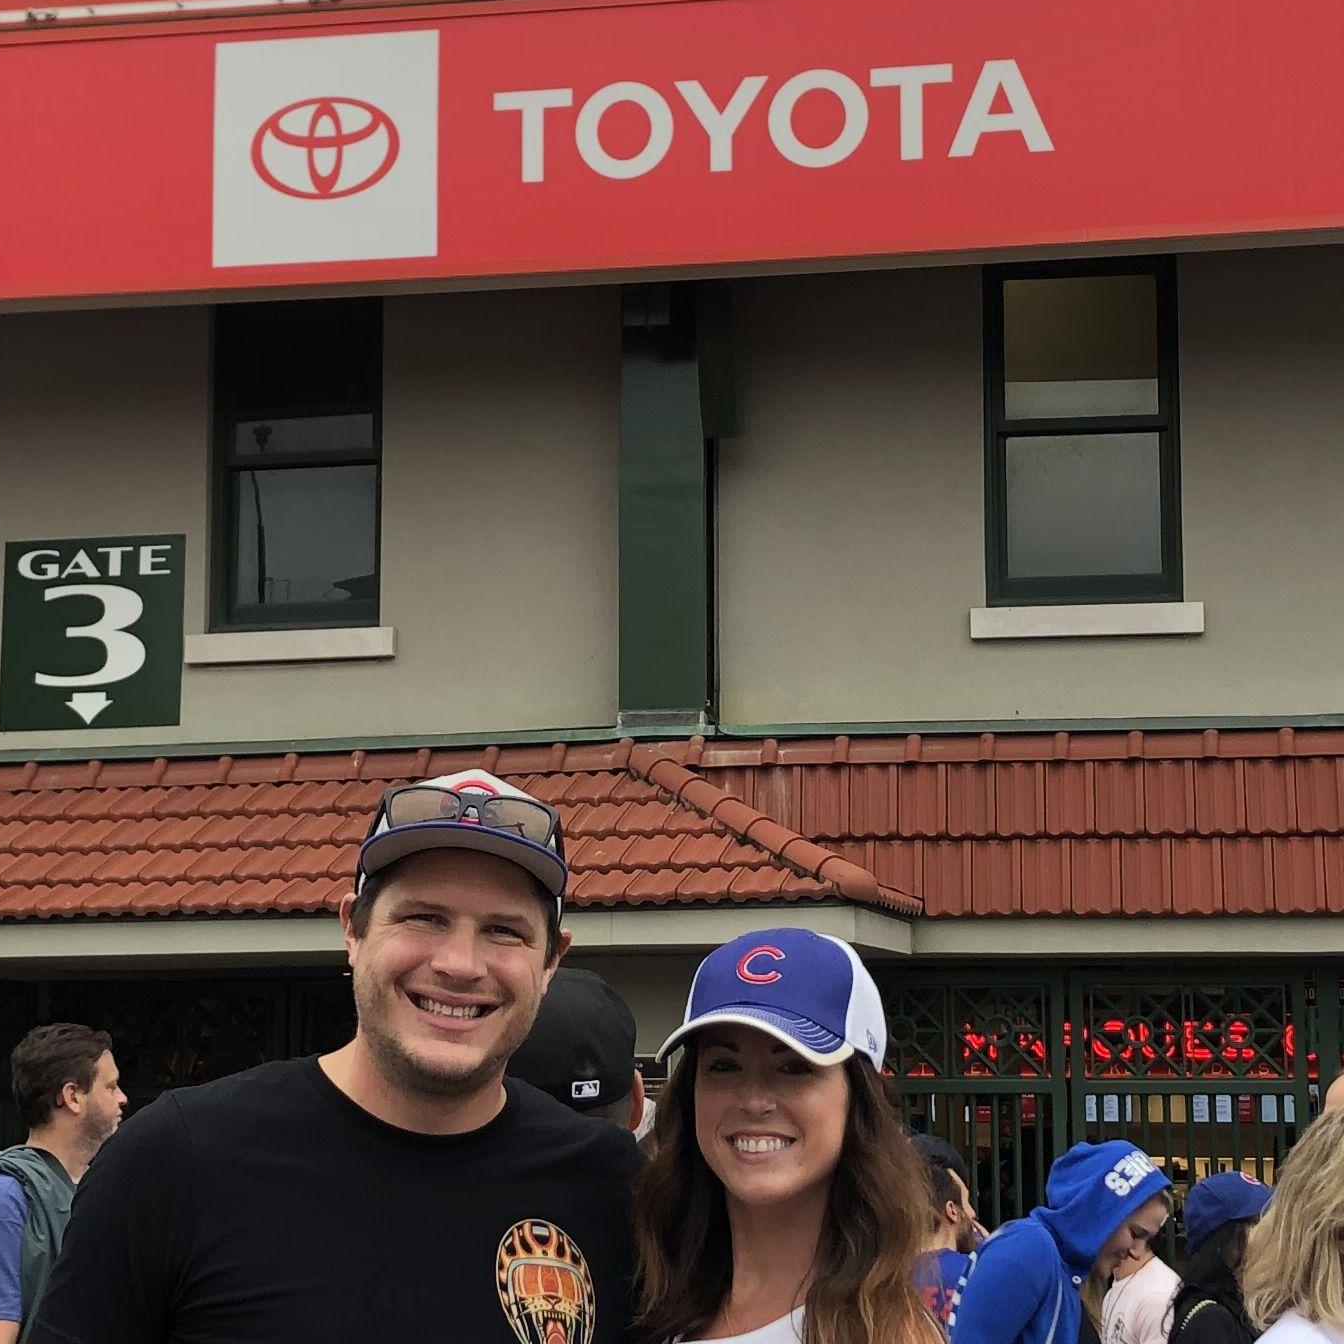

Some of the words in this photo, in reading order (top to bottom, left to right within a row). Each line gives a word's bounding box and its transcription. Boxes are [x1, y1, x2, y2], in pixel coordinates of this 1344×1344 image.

[493, 59, 1054, 183] TOYOTA
[18, 545, 172, 580] GATE
[35, 584, 146, 687] 3
[736, 944, 785, 985] C
